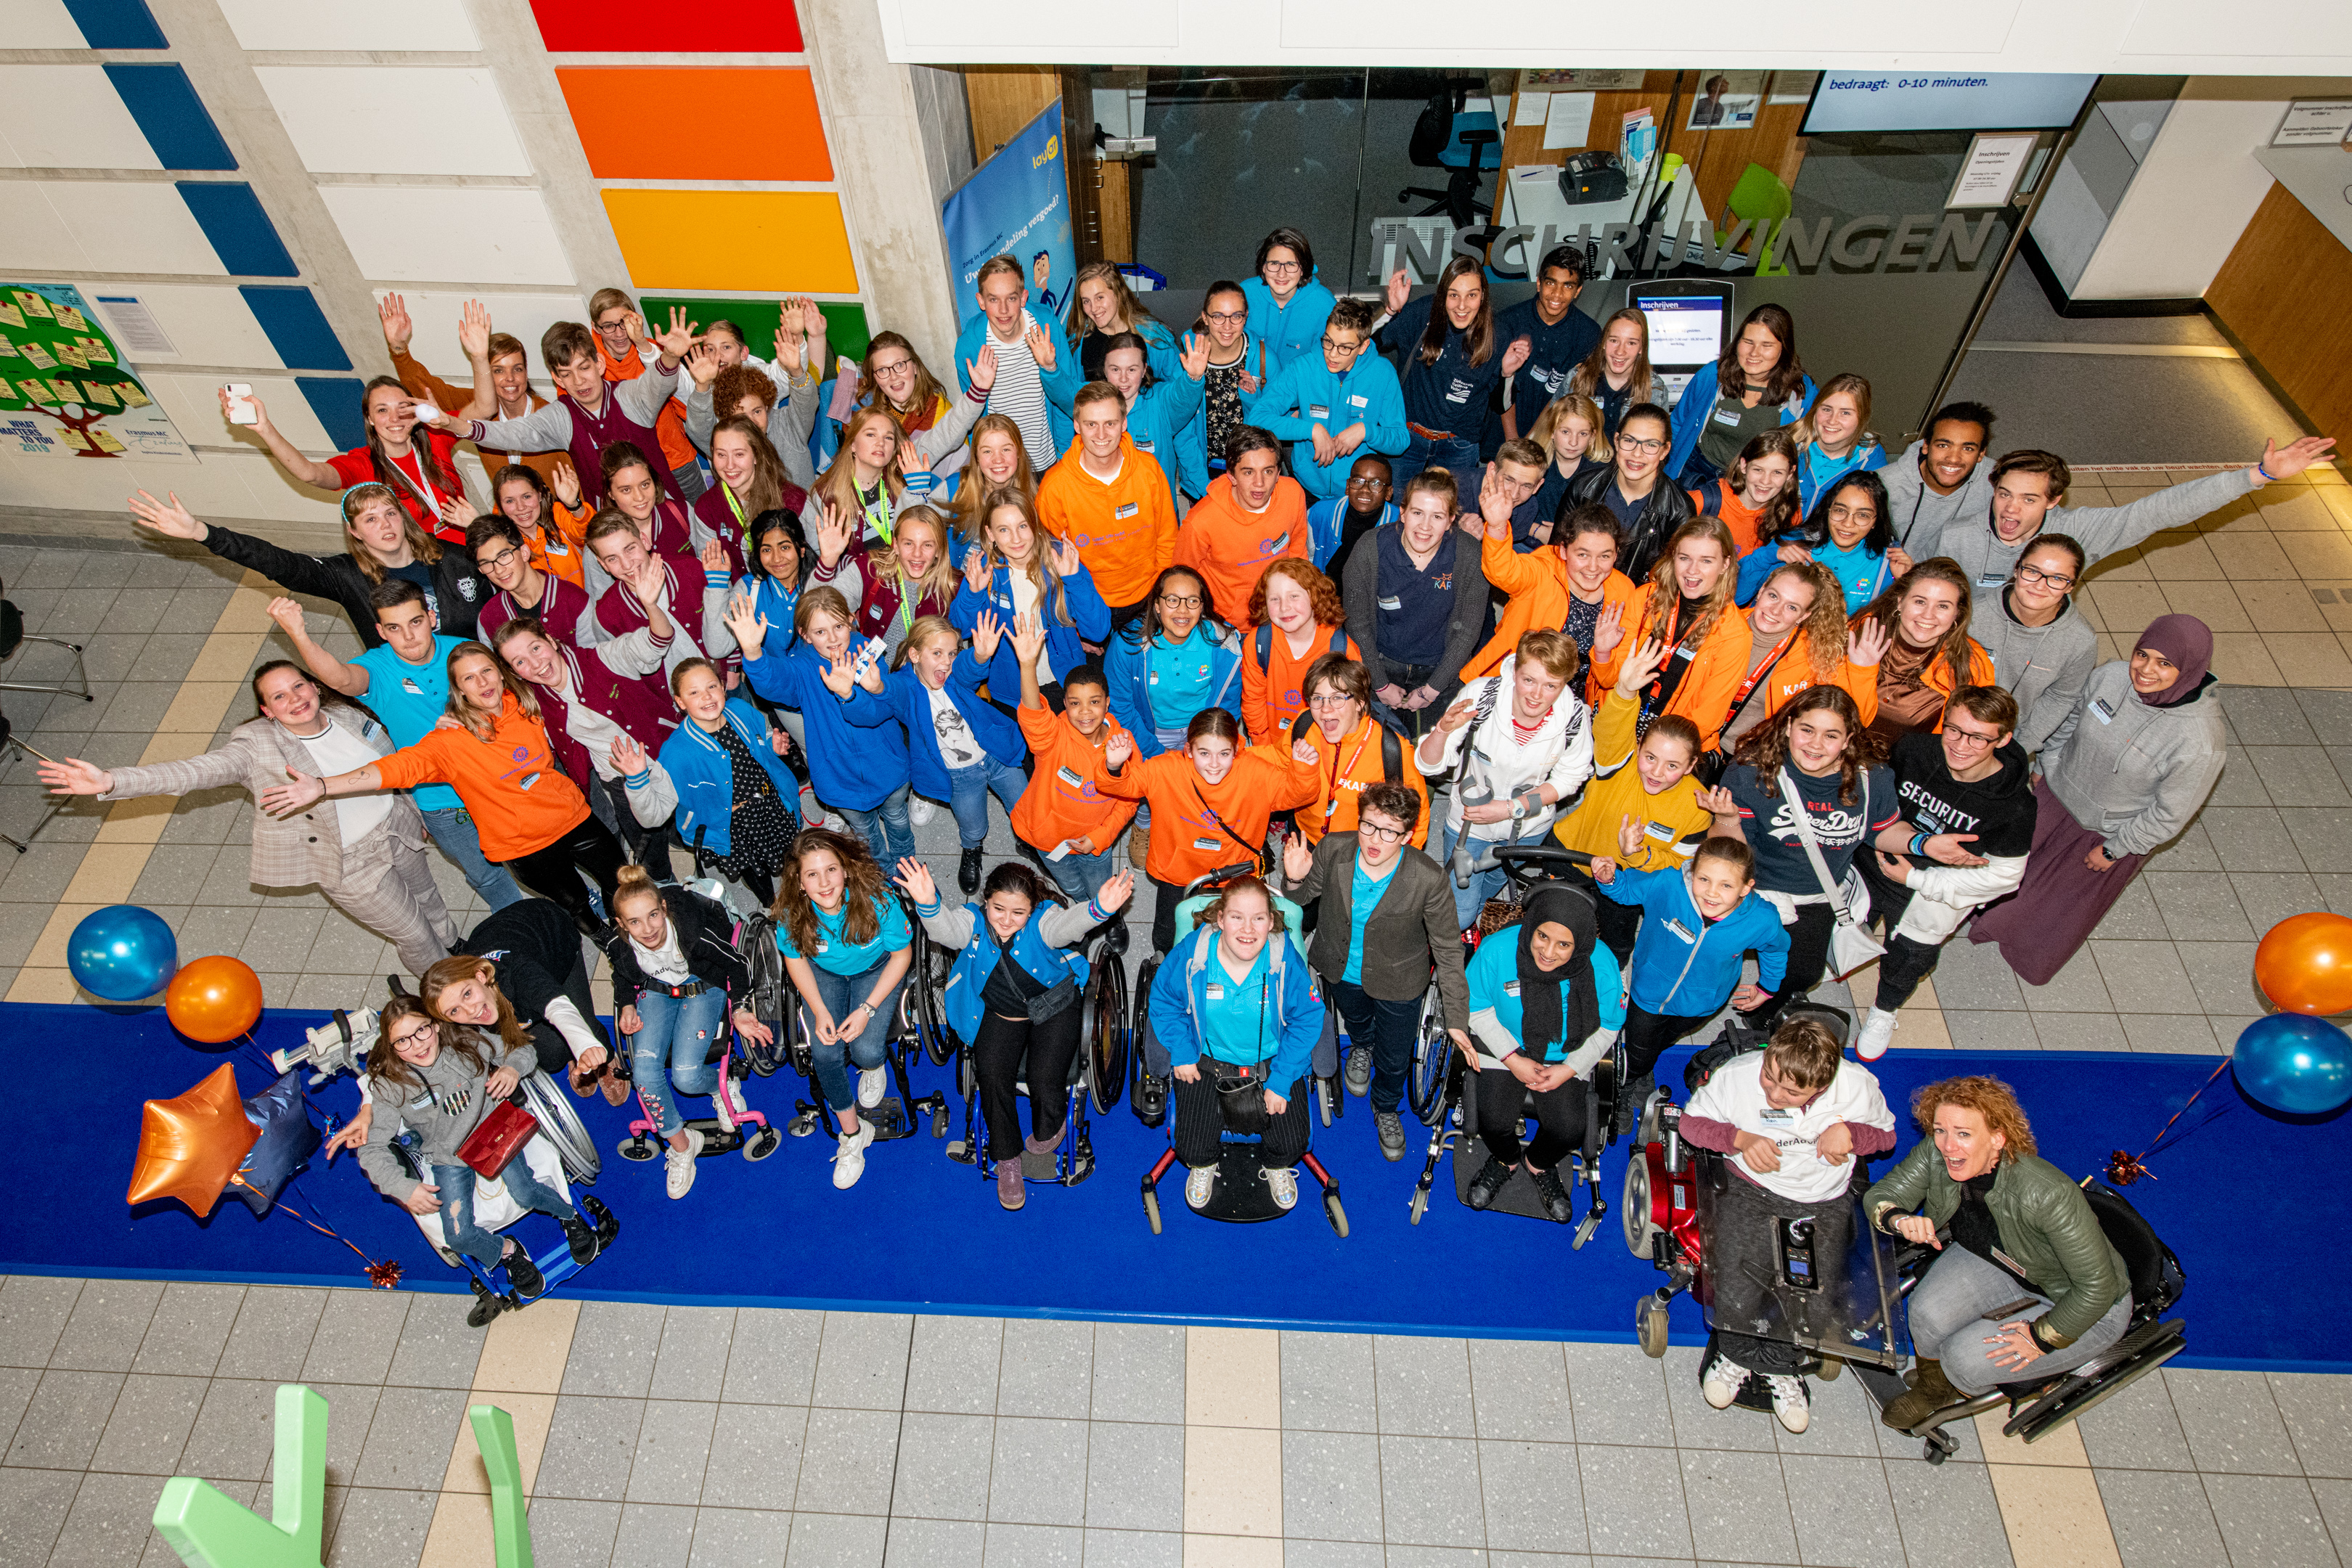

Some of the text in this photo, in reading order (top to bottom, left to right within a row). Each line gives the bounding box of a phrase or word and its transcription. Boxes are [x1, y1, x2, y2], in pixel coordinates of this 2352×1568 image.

[1829, 76, 1989, 91] bedraagt: 0-10 minuten.
[1032, 134, 1059, 170] layar
[1028, 194, 1059, 229] vergoed?
[980, 240, 997, 256] Erasmus
[1369, 213, 1997, 280] INSCHRIJVINGEN
[1640, 301, 1679, 311] Inschrijven
[7, 420, 37, 429] WHAT
[0, 428, 43, 437] MATTERS
[33, 436, 55, 445] YOU
[19, 443, 50, 453] 2019
[1434, 580, 1451, 590] KAR
[1807, 801, 1835, 812] REAL
[1899, 780, 1980, 832] SECURITY
